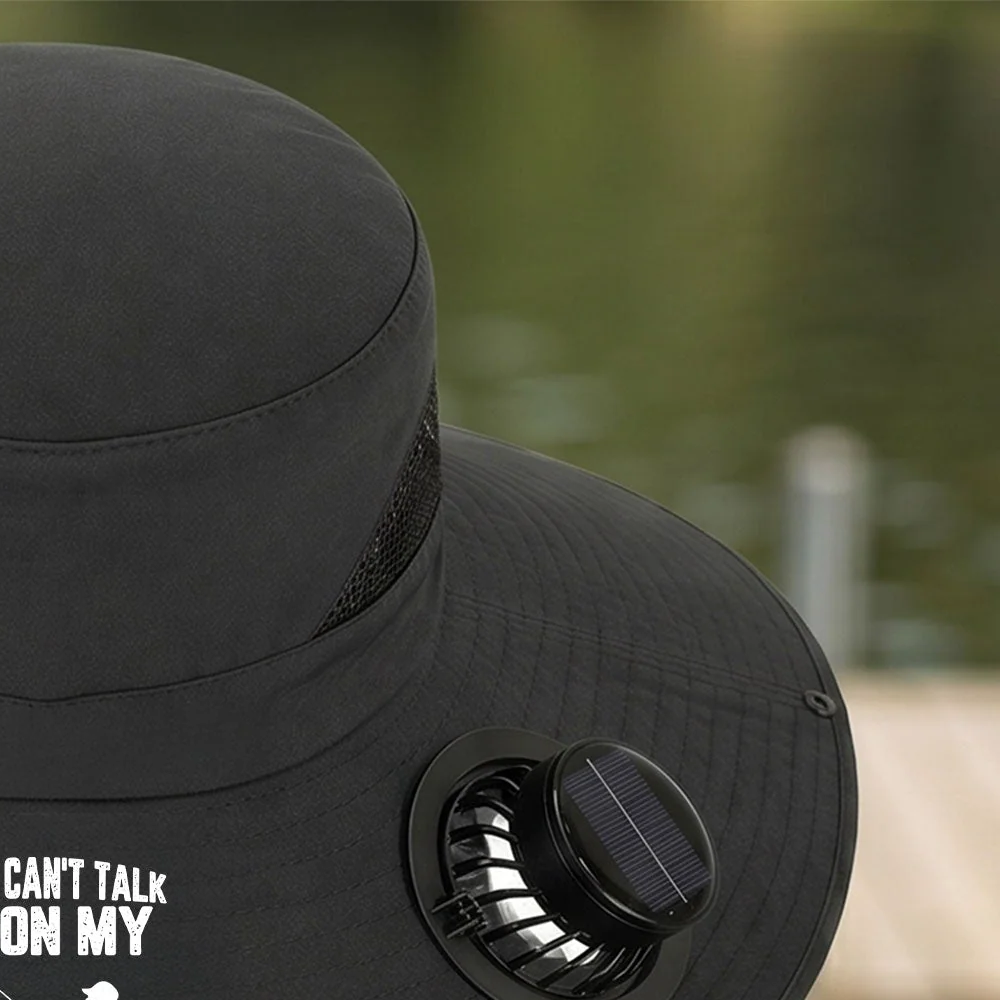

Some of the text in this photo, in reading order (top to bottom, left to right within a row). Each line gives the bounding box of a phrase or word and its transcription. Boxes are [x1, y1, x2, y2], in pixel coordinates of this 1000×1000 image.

[3, 856, 85, 900] CAN'T
[93, 860, 168, 905] TALK
[0, 905, 61, 956] ON
[77, 905, 154, 956] MY
